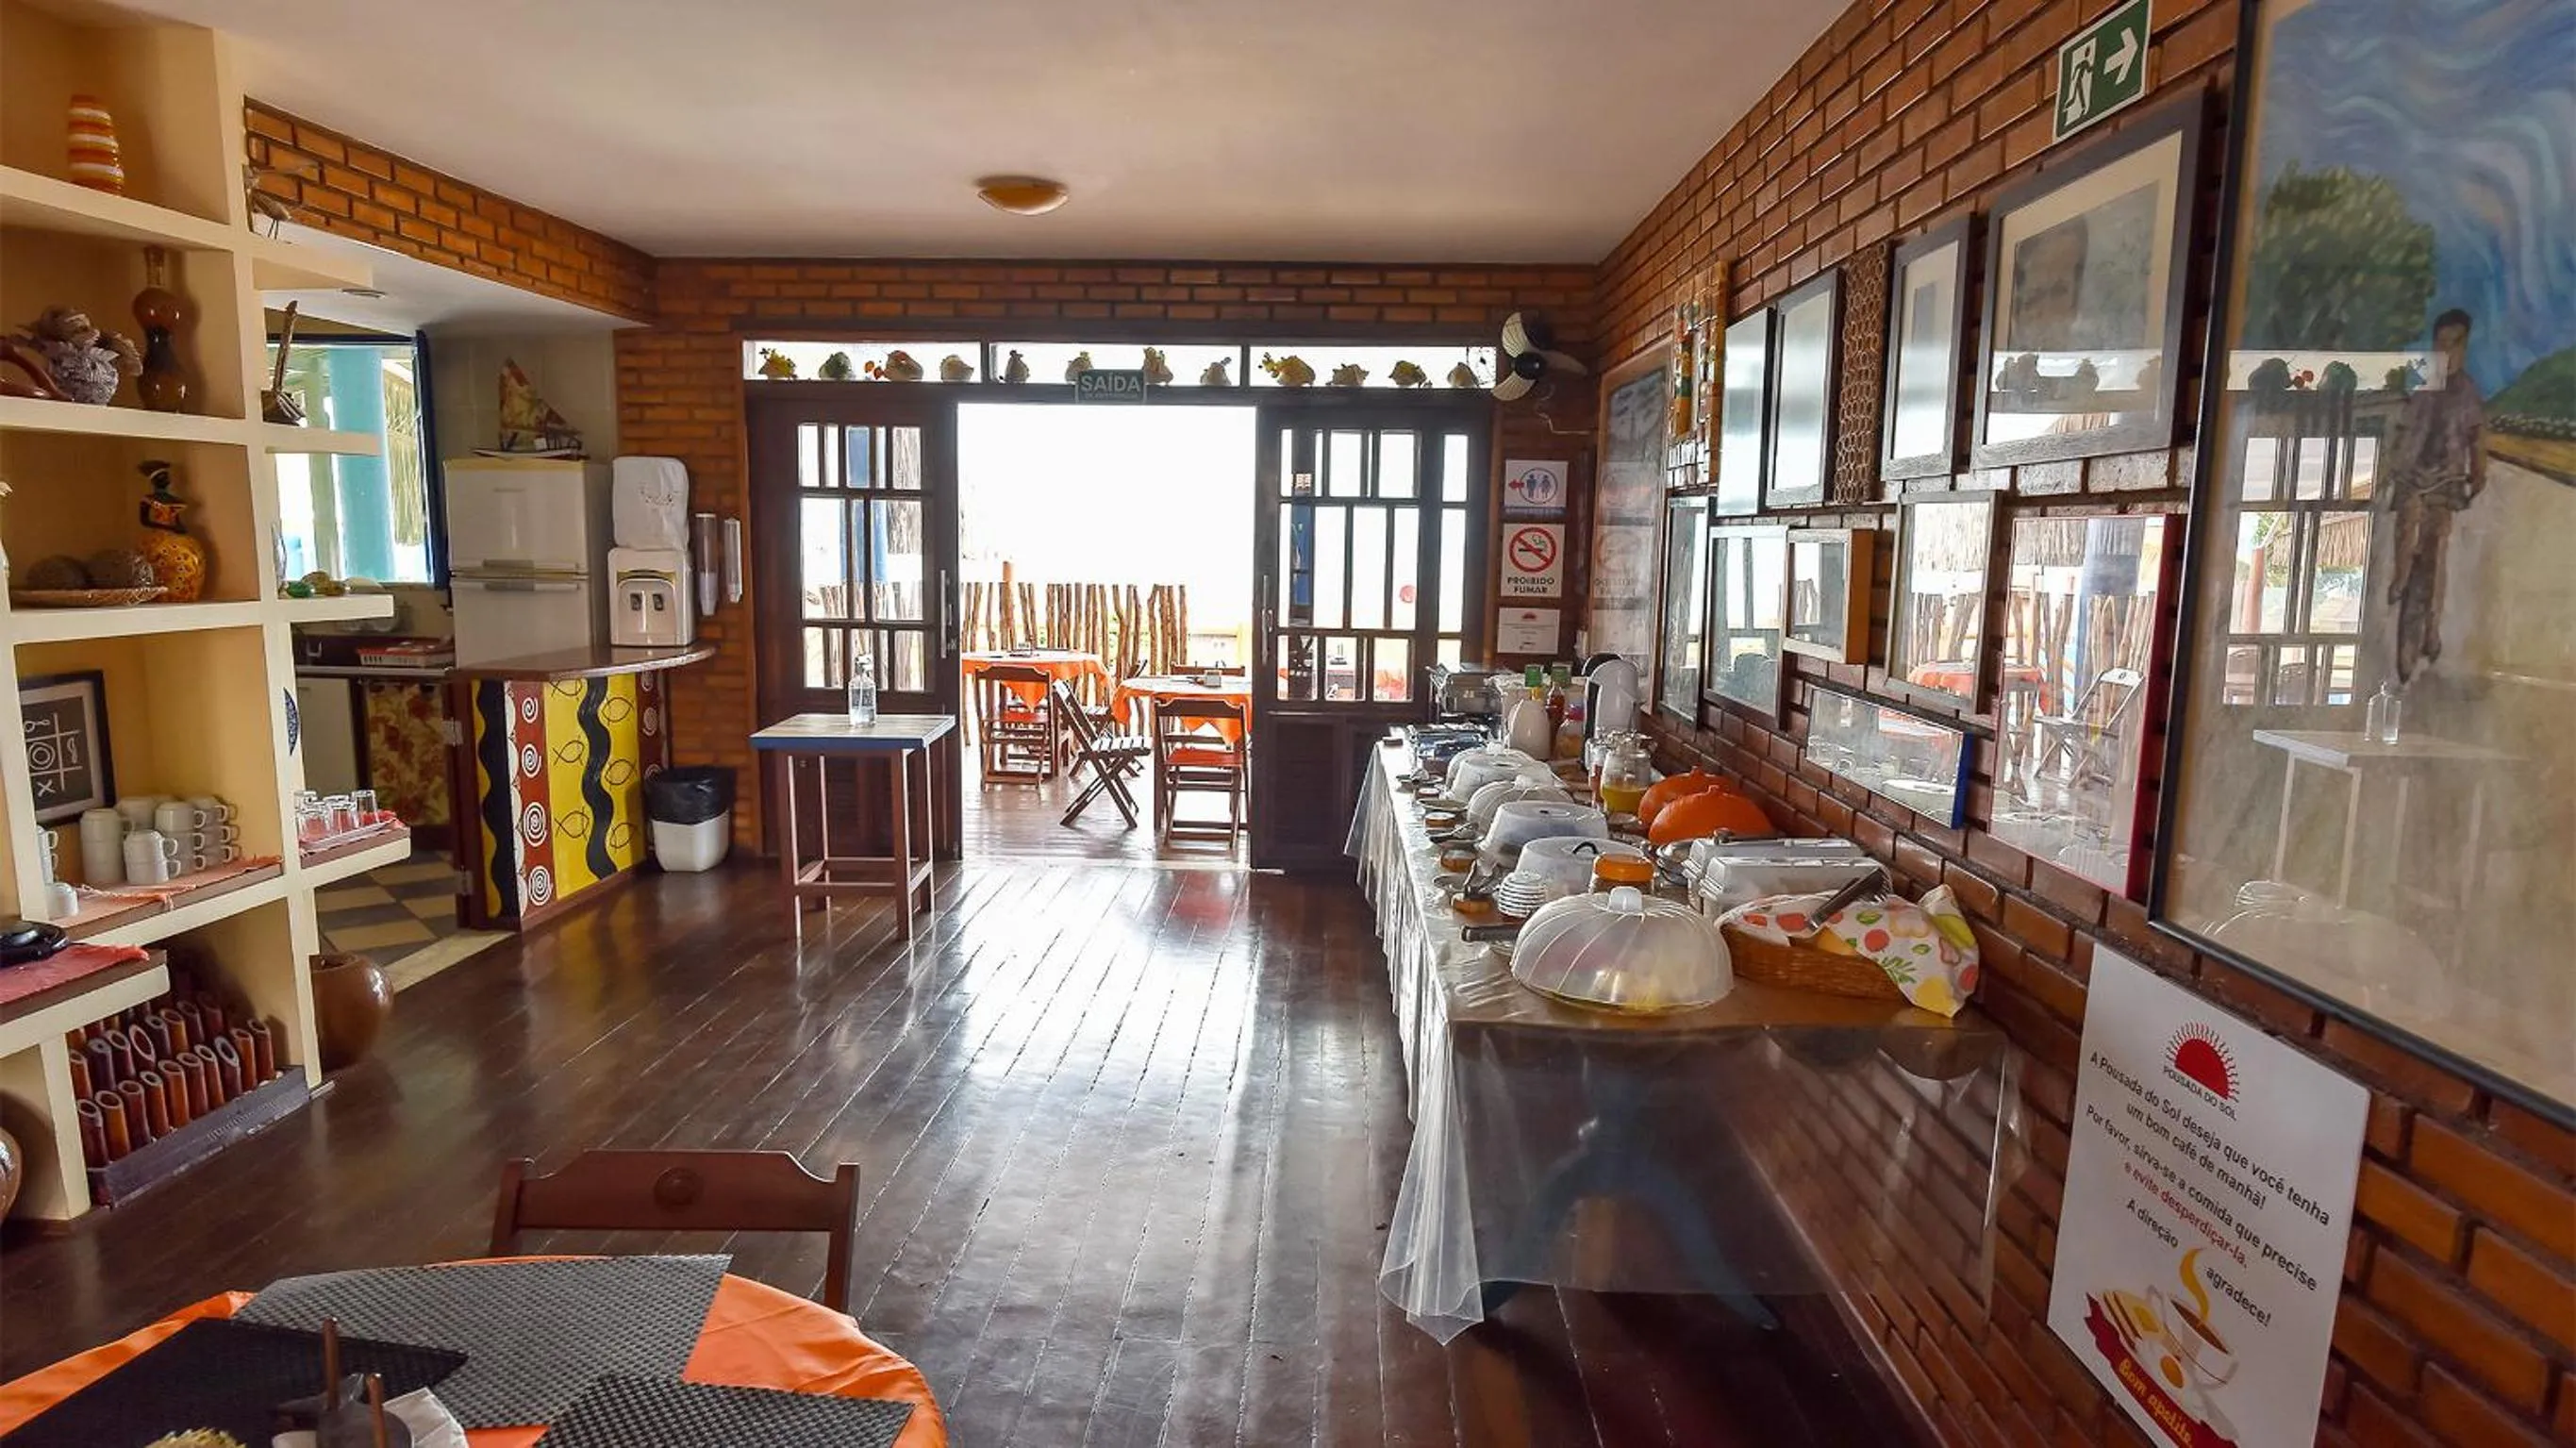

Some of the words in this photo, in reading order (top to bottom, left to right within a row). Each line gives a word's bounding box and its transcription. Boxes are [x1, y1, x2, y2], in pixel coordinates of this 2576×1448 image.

[1080, 373, 1141, 392] SAÍDA
[1507, 576, 1555, 585] PROIBIDO
[2164, 1065, 2202, 1098] POUSADA
[2203, 1091, 2218, 1107] DO
[2219, 1102, 2237, 1122] SOL
[2090, 1051, 2098, 1065] A
[2099, 1057, 2143, 1095] Pousada
[2144, 1090, 2159, 1107] do
[2162, 1099, 2182, 1122] Sol
[2182, 1115, 2221, 1151] deseja
[2223, 1145, 2249, 1169] que
[2252, 1163, 2285, 1193] você
[2286, 1187, 2330, 1225] tenha
[2127, 1104, 2144, 1123] um
[2146, 1113, 2170, 1140] bom
[2172, 1136, 2198, 1160] café
[2199, 1156, 2215, 1173] de
[2217, 1168, 2266, 1209] manhã!
[2086, 1105, 2103, 1125] Por
[2104, 1119, 2131, 1150] favor,
[2133, 1144, 2177, 1182] sirva-se
[2178, 1178, 2186, 1190] a
[2188, 1187, 2234, 1226] comida
[2235, 1223, 2261, 1248] que
[2261, 1243, 2317, 1291] precise
[2124, 1161, 2132, 1173] e
[2133, 1169, 2159, 1194] evite
[2127, 1199, 2136, 1213] A
[2137, 1208, 2179, 1248] direção
[2206, 1267, 2271, 1327] agradece!
[2119, 1358, 2147, 1396] Bom
